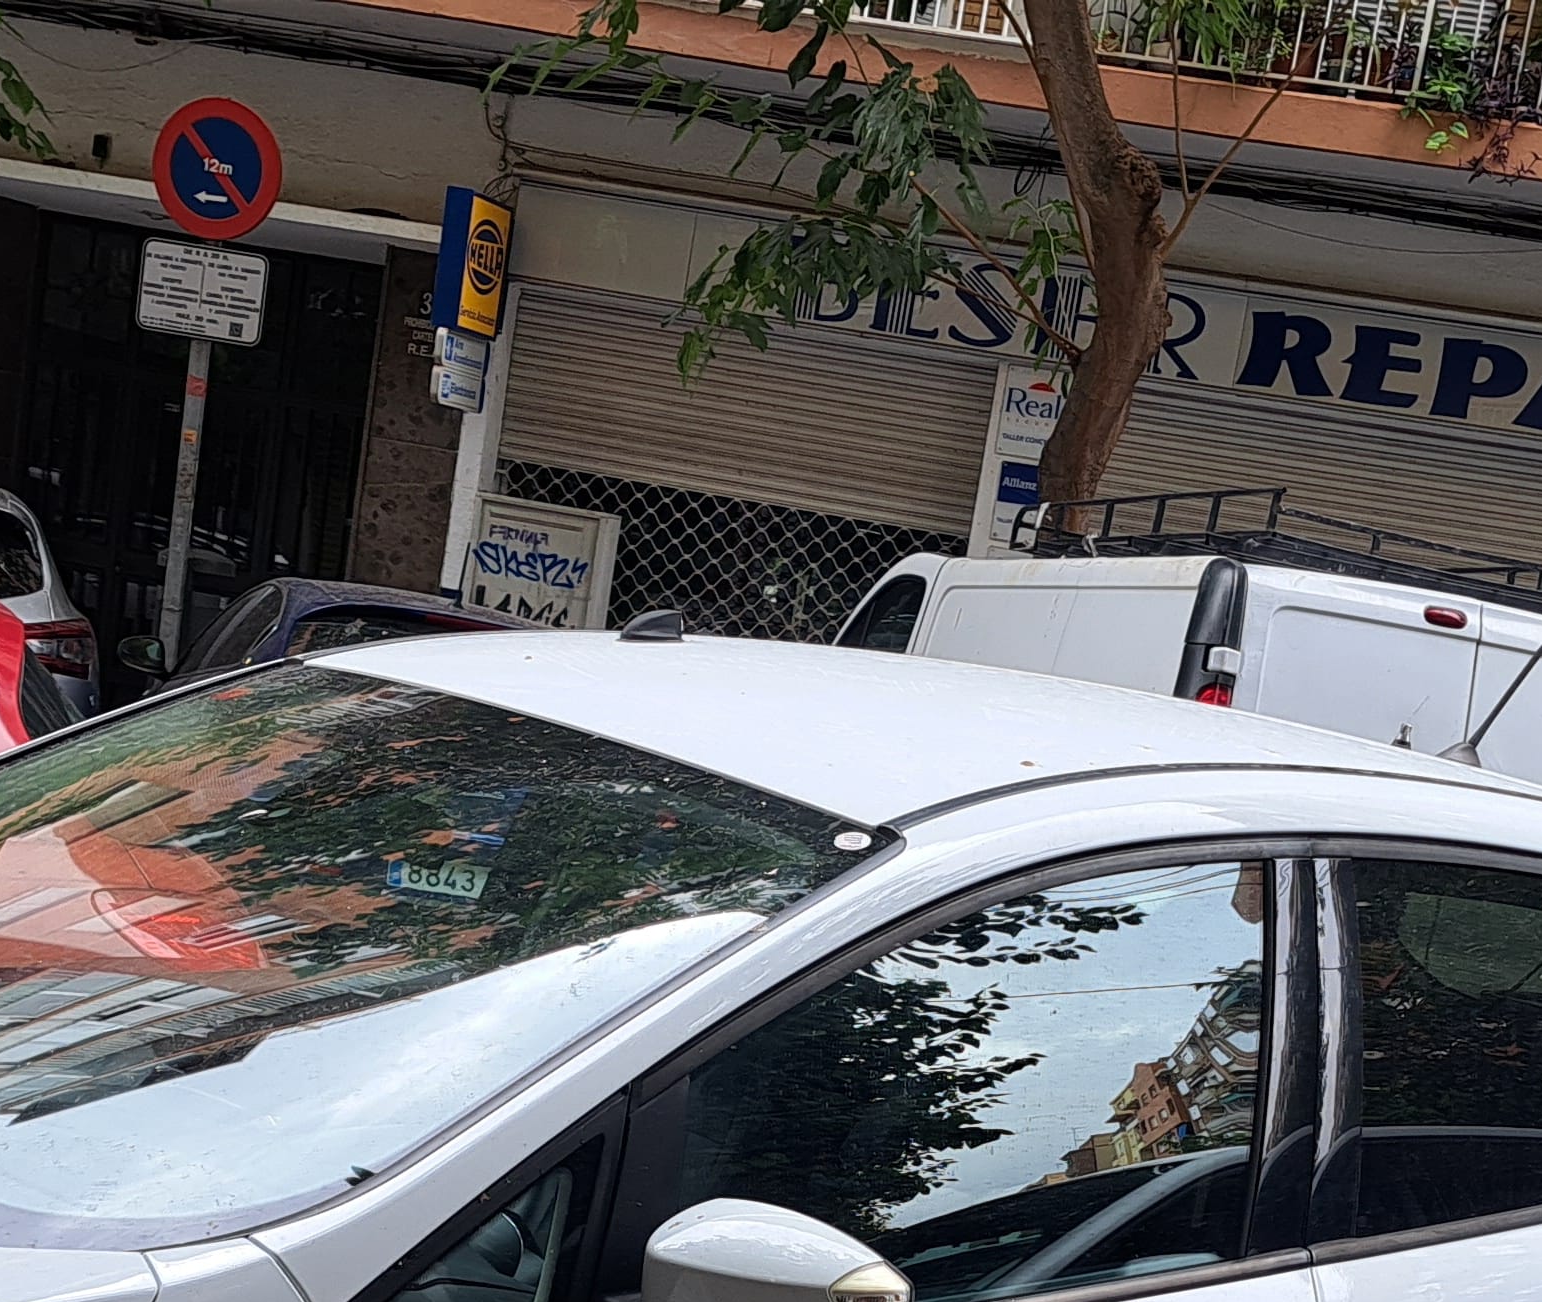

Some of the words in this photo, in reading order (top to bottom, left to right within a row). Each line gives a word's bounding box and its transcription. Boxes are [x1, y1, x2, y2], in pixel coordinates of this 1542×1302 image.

[203, 157, 233, 175] 12m
[470, 243, 504, 279] HELLA
[1005, 387, 1061, 420] Real
[1002, 476, 1037, 491] Allianz
[409, 869, 475, 892] 8843
